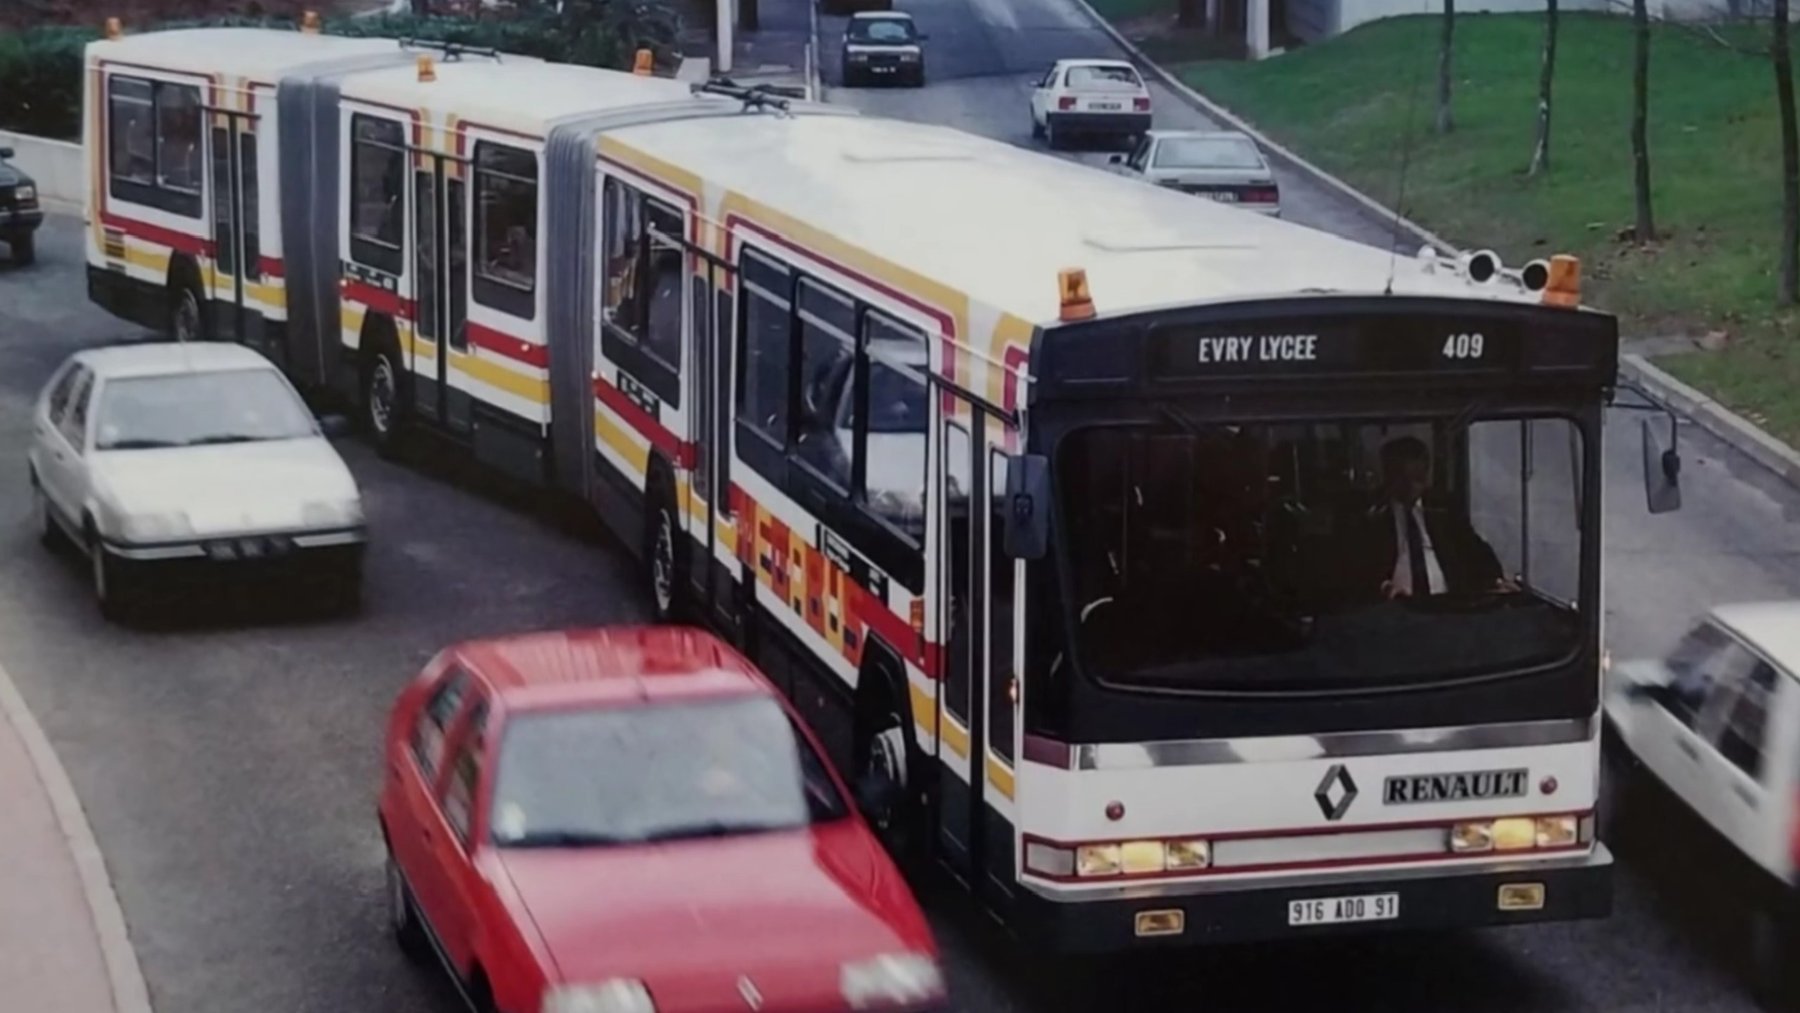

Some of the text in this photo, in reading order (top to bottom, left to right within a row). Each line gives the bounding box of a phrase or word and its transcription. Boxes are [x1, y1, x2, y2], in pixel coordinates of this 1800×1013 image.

[1199, 335, 1318, 363] EVRY LYCEE
[1443, 333, 1485, 359] 409
[1388, 771, 1527, 802] RENAULT
[1293, 901, 1324, 922] 916
[1375, 896, 1394, 917] 91
